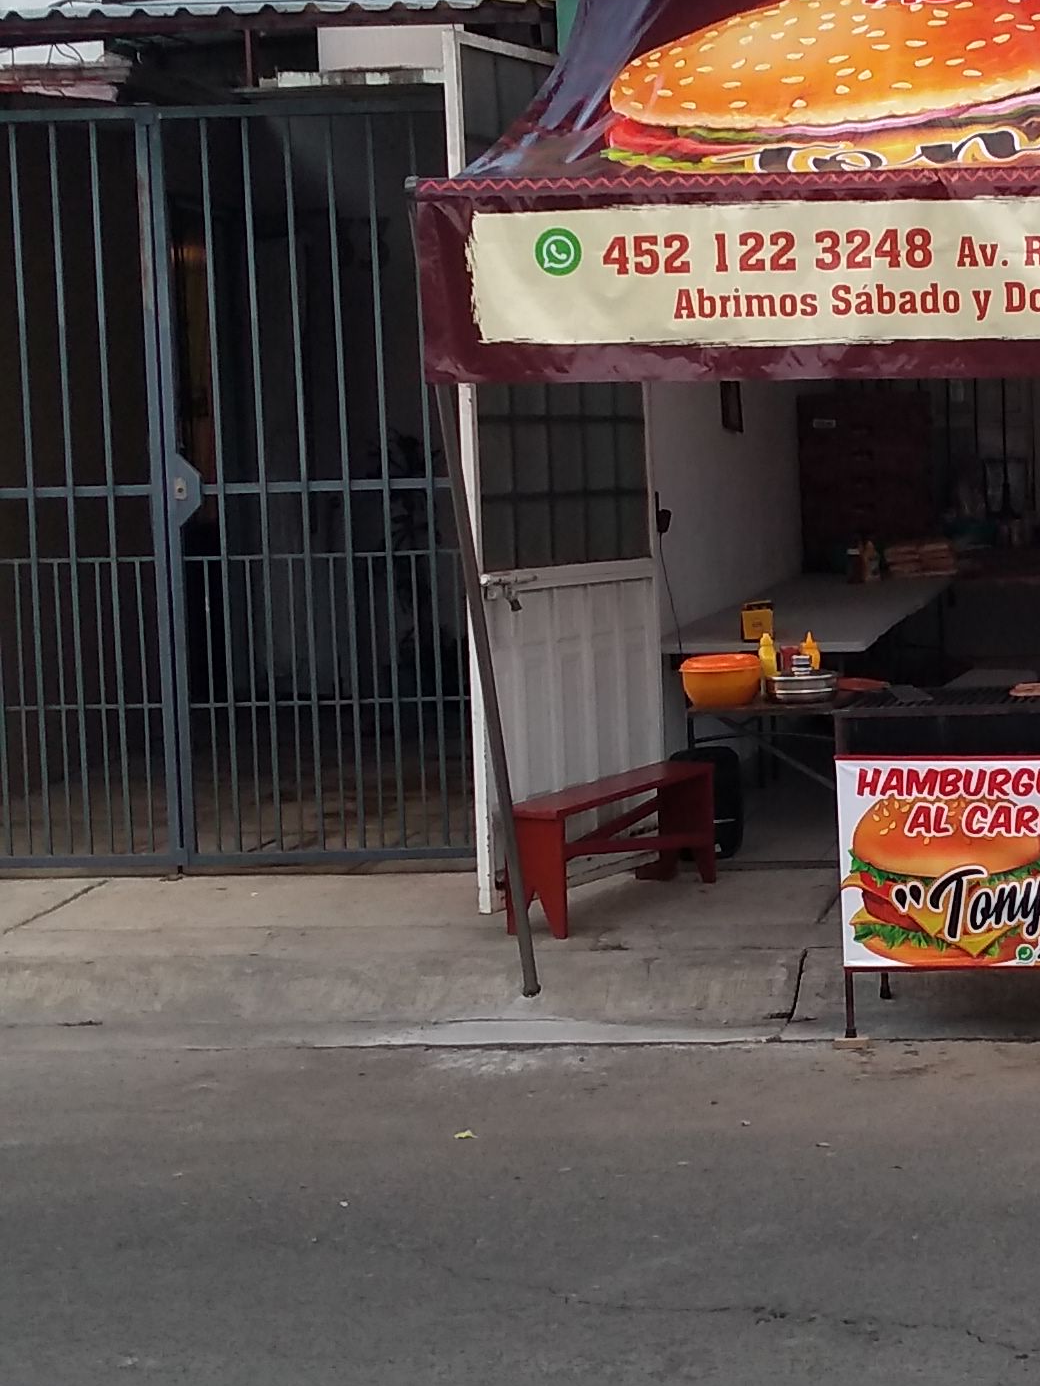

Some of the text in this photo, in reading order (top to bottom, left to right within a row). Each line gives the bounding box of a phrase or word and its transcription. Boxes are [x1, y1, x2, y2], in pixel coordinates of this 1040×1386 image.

[602, 234, 691, 275] 452
[714, 231, 797, 273] 122
[814, 228, 933, 270] 3248
[956, 236, 1009, 268] Av.
[673, 287, 818, 319] Abrimos
[832, 282, 960, 316] Sábado
[972, 289, 992, 321] y
[906, 804, 951, 834] AL
